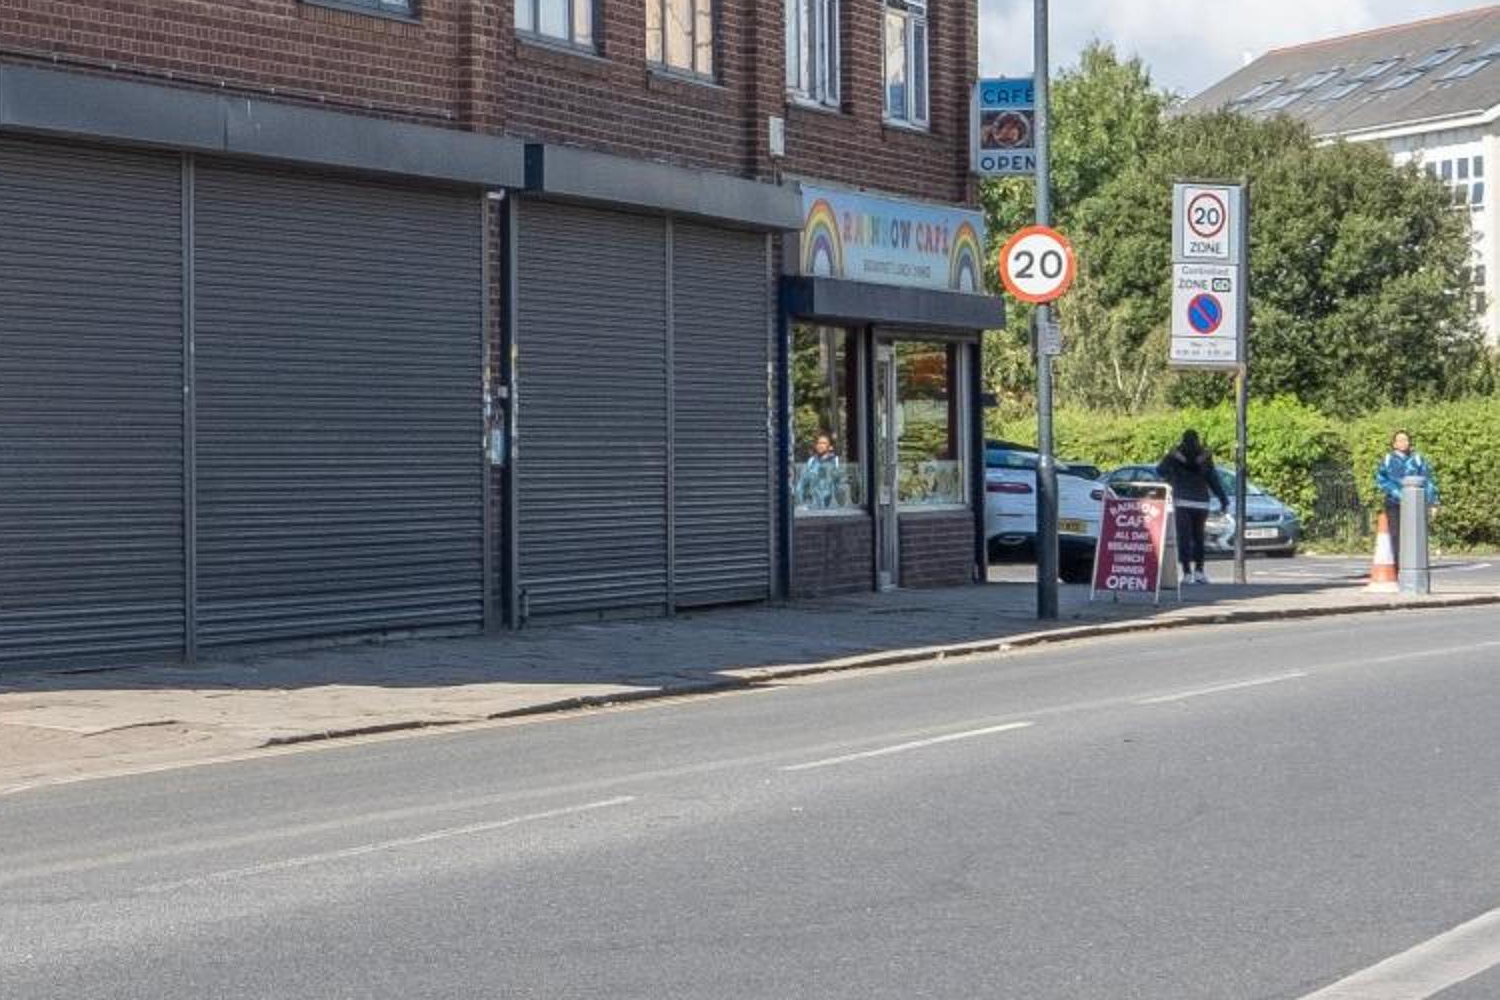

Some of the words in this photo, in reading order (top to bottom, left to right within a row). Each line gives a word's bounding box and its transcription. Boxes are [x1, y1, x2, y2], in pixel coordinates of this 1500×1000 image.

[980, 155, 1037, 172] OPEN
[1194, 207, 1221, 226] 20
[1189, 241, 1222, 254] ZONE
[1014, 249, 1063, 279] 20
[1105, 575, 1148, 590] OPEN
